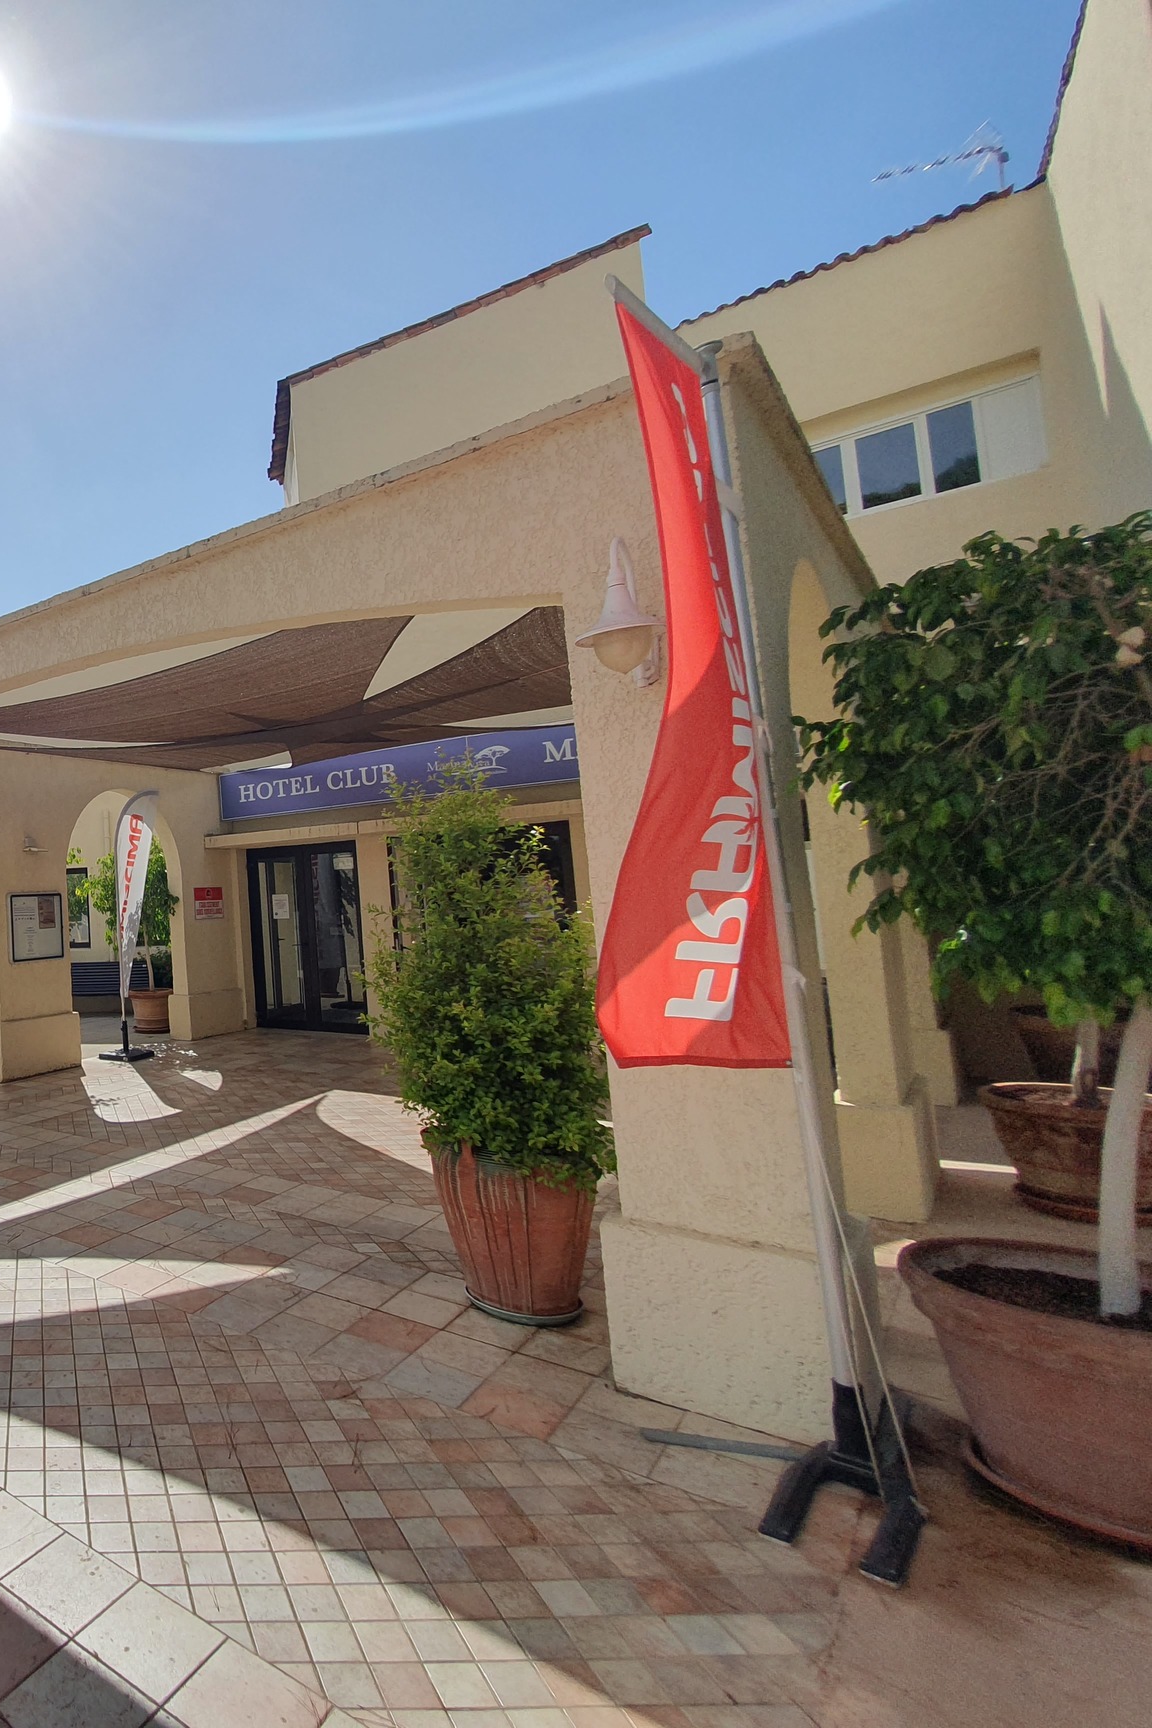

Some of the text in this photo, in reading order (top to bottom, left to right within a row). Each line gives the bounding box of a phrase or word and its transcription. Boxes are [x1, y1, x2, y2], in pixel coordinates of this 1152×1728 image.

[239, 738, 579, 802] HOTEL CLUB M
